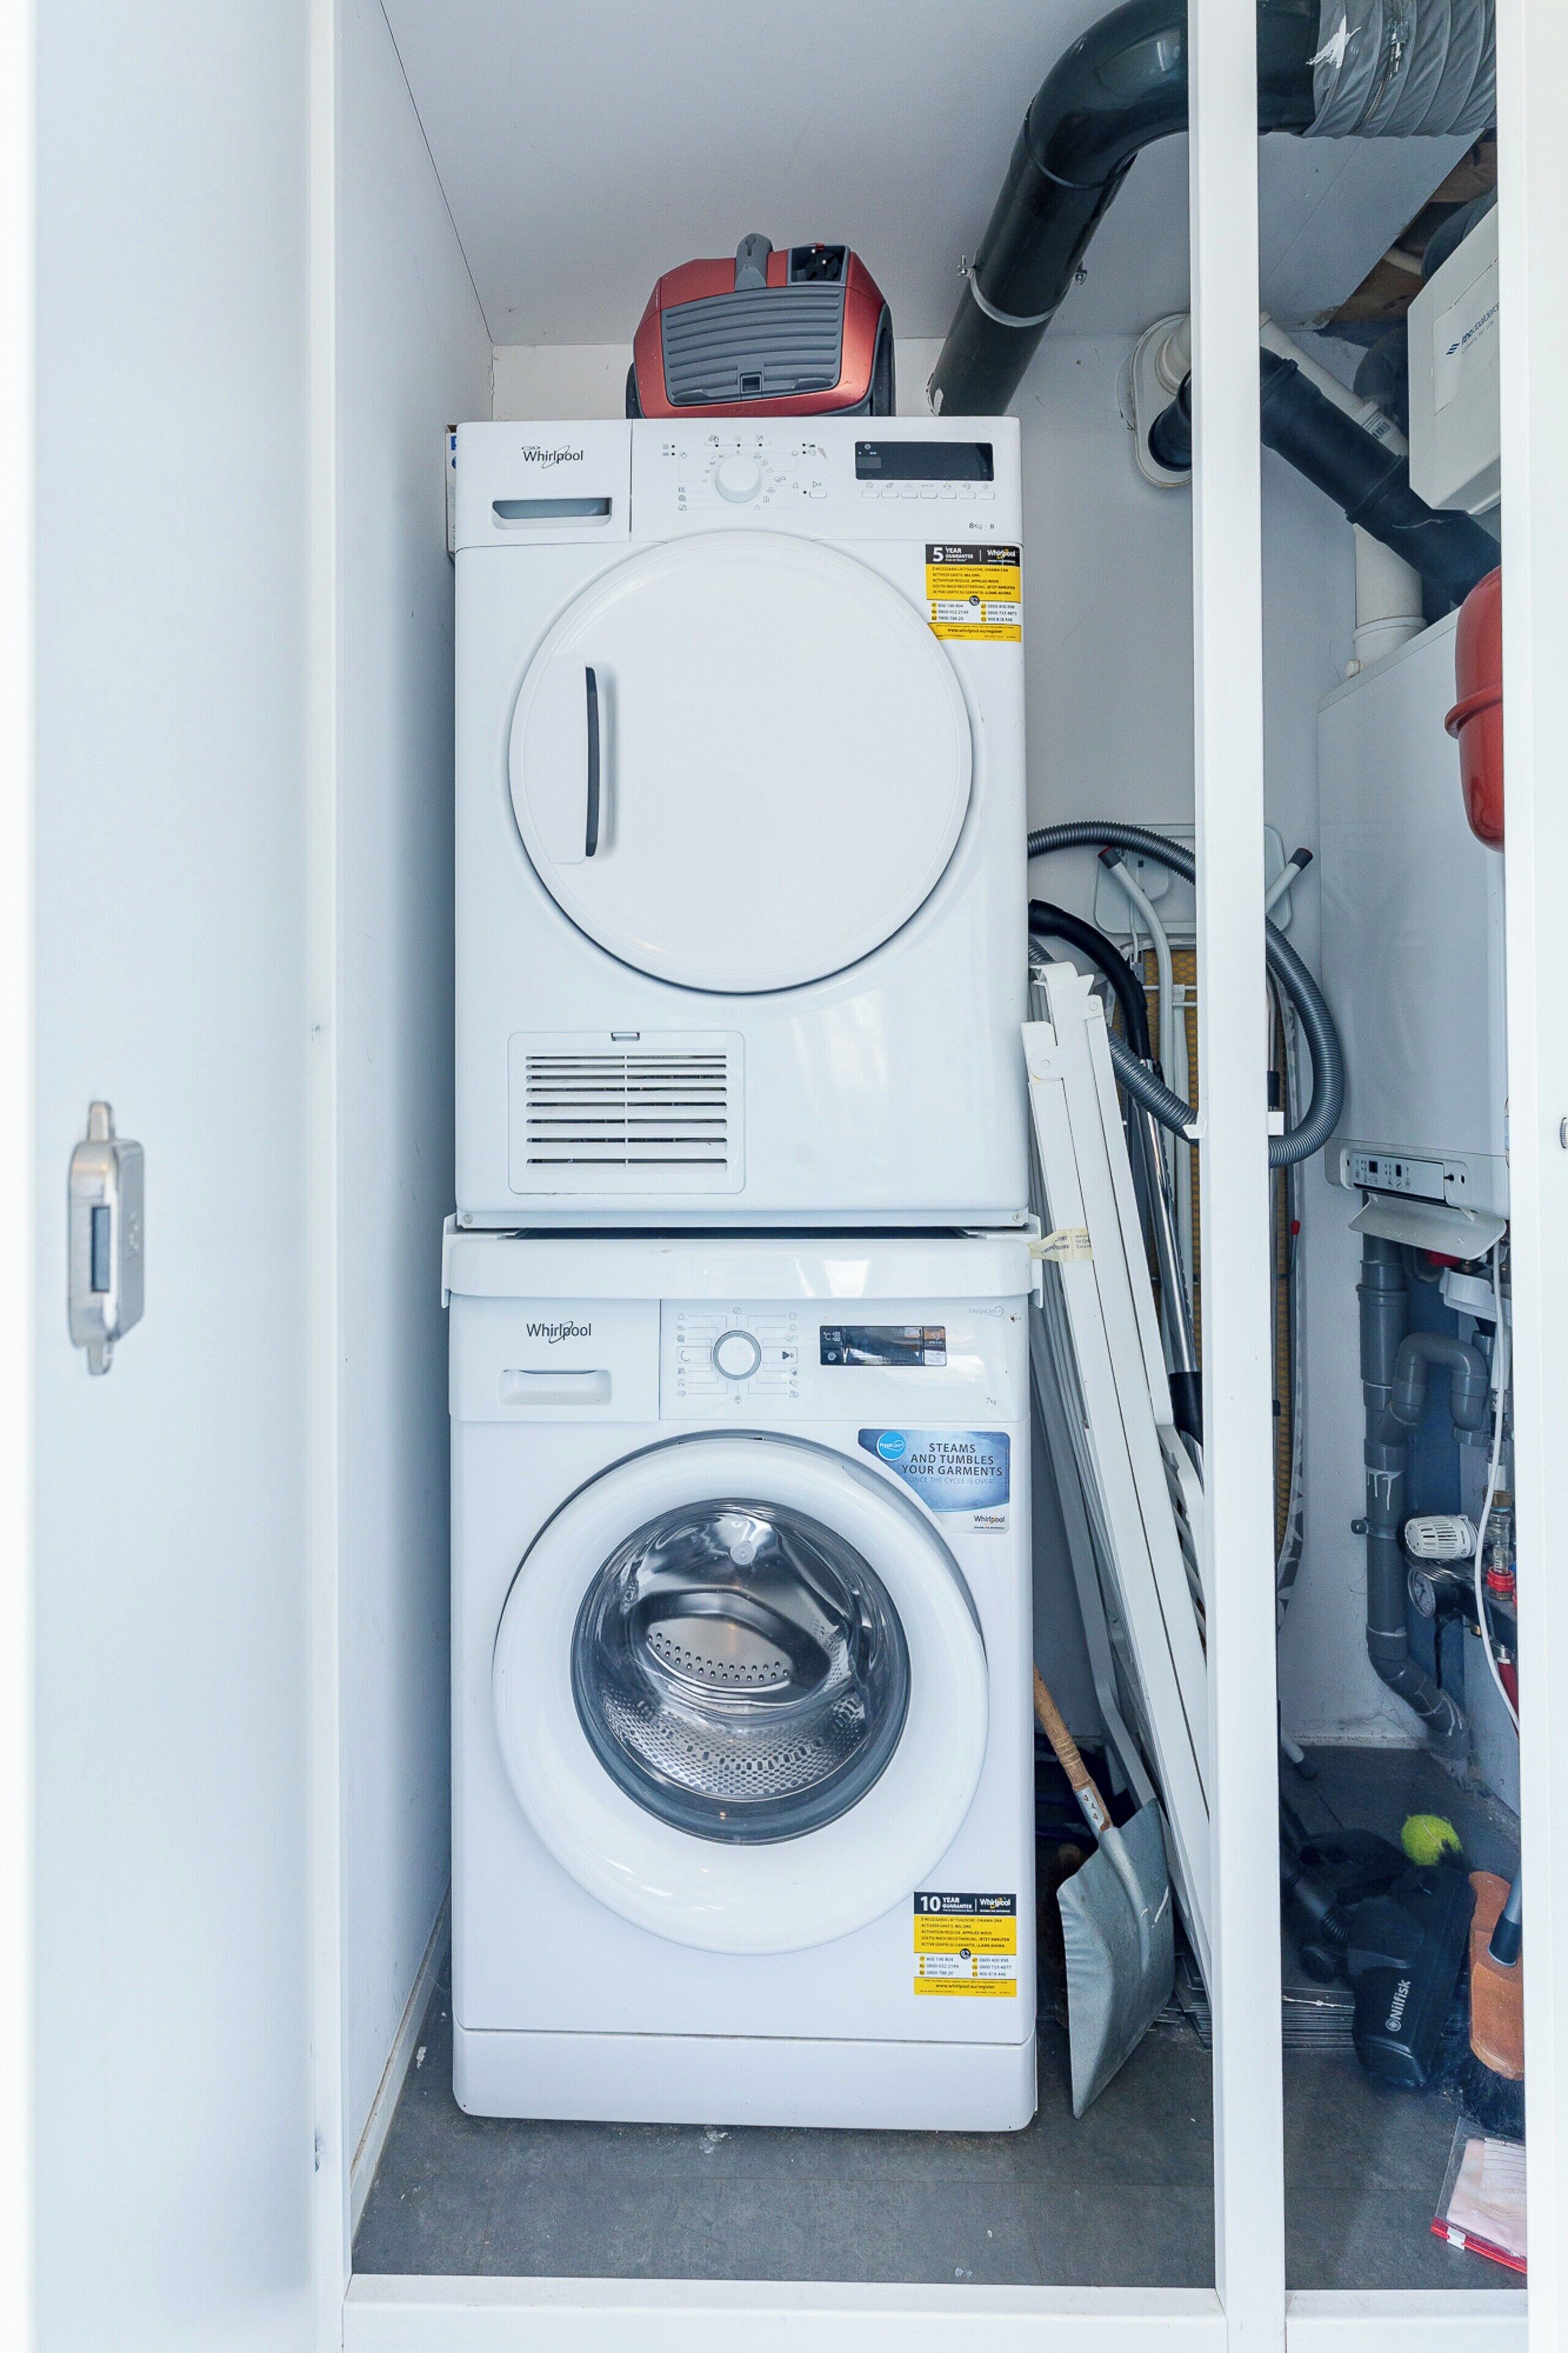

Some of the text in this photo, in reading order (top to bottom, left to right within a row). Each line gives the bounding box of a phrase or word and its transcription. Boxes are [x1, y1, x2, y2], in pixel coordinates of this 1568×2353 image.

[523, 447, 583, 467] Whirlpool
[933, 547, 944, 562] 5
[987, 549, 1016, 559] Whirlpool
[526, 1322, 592, 1343] Whirlpool
[929, 1443, 976, 1453] STEAMS
[911, 1454, 994, 1465] AND TUMBLES
[902, 1464, 1003, 1476] YOUR GARMENTS
[974, 1515, 1005, 1524] Whirlpool
[920, 1896, 941, 1912] 10
[980, 1898, 1011, 1908] Whirlpool
[1389, 1979, 1411, 2021] Nilfisk
